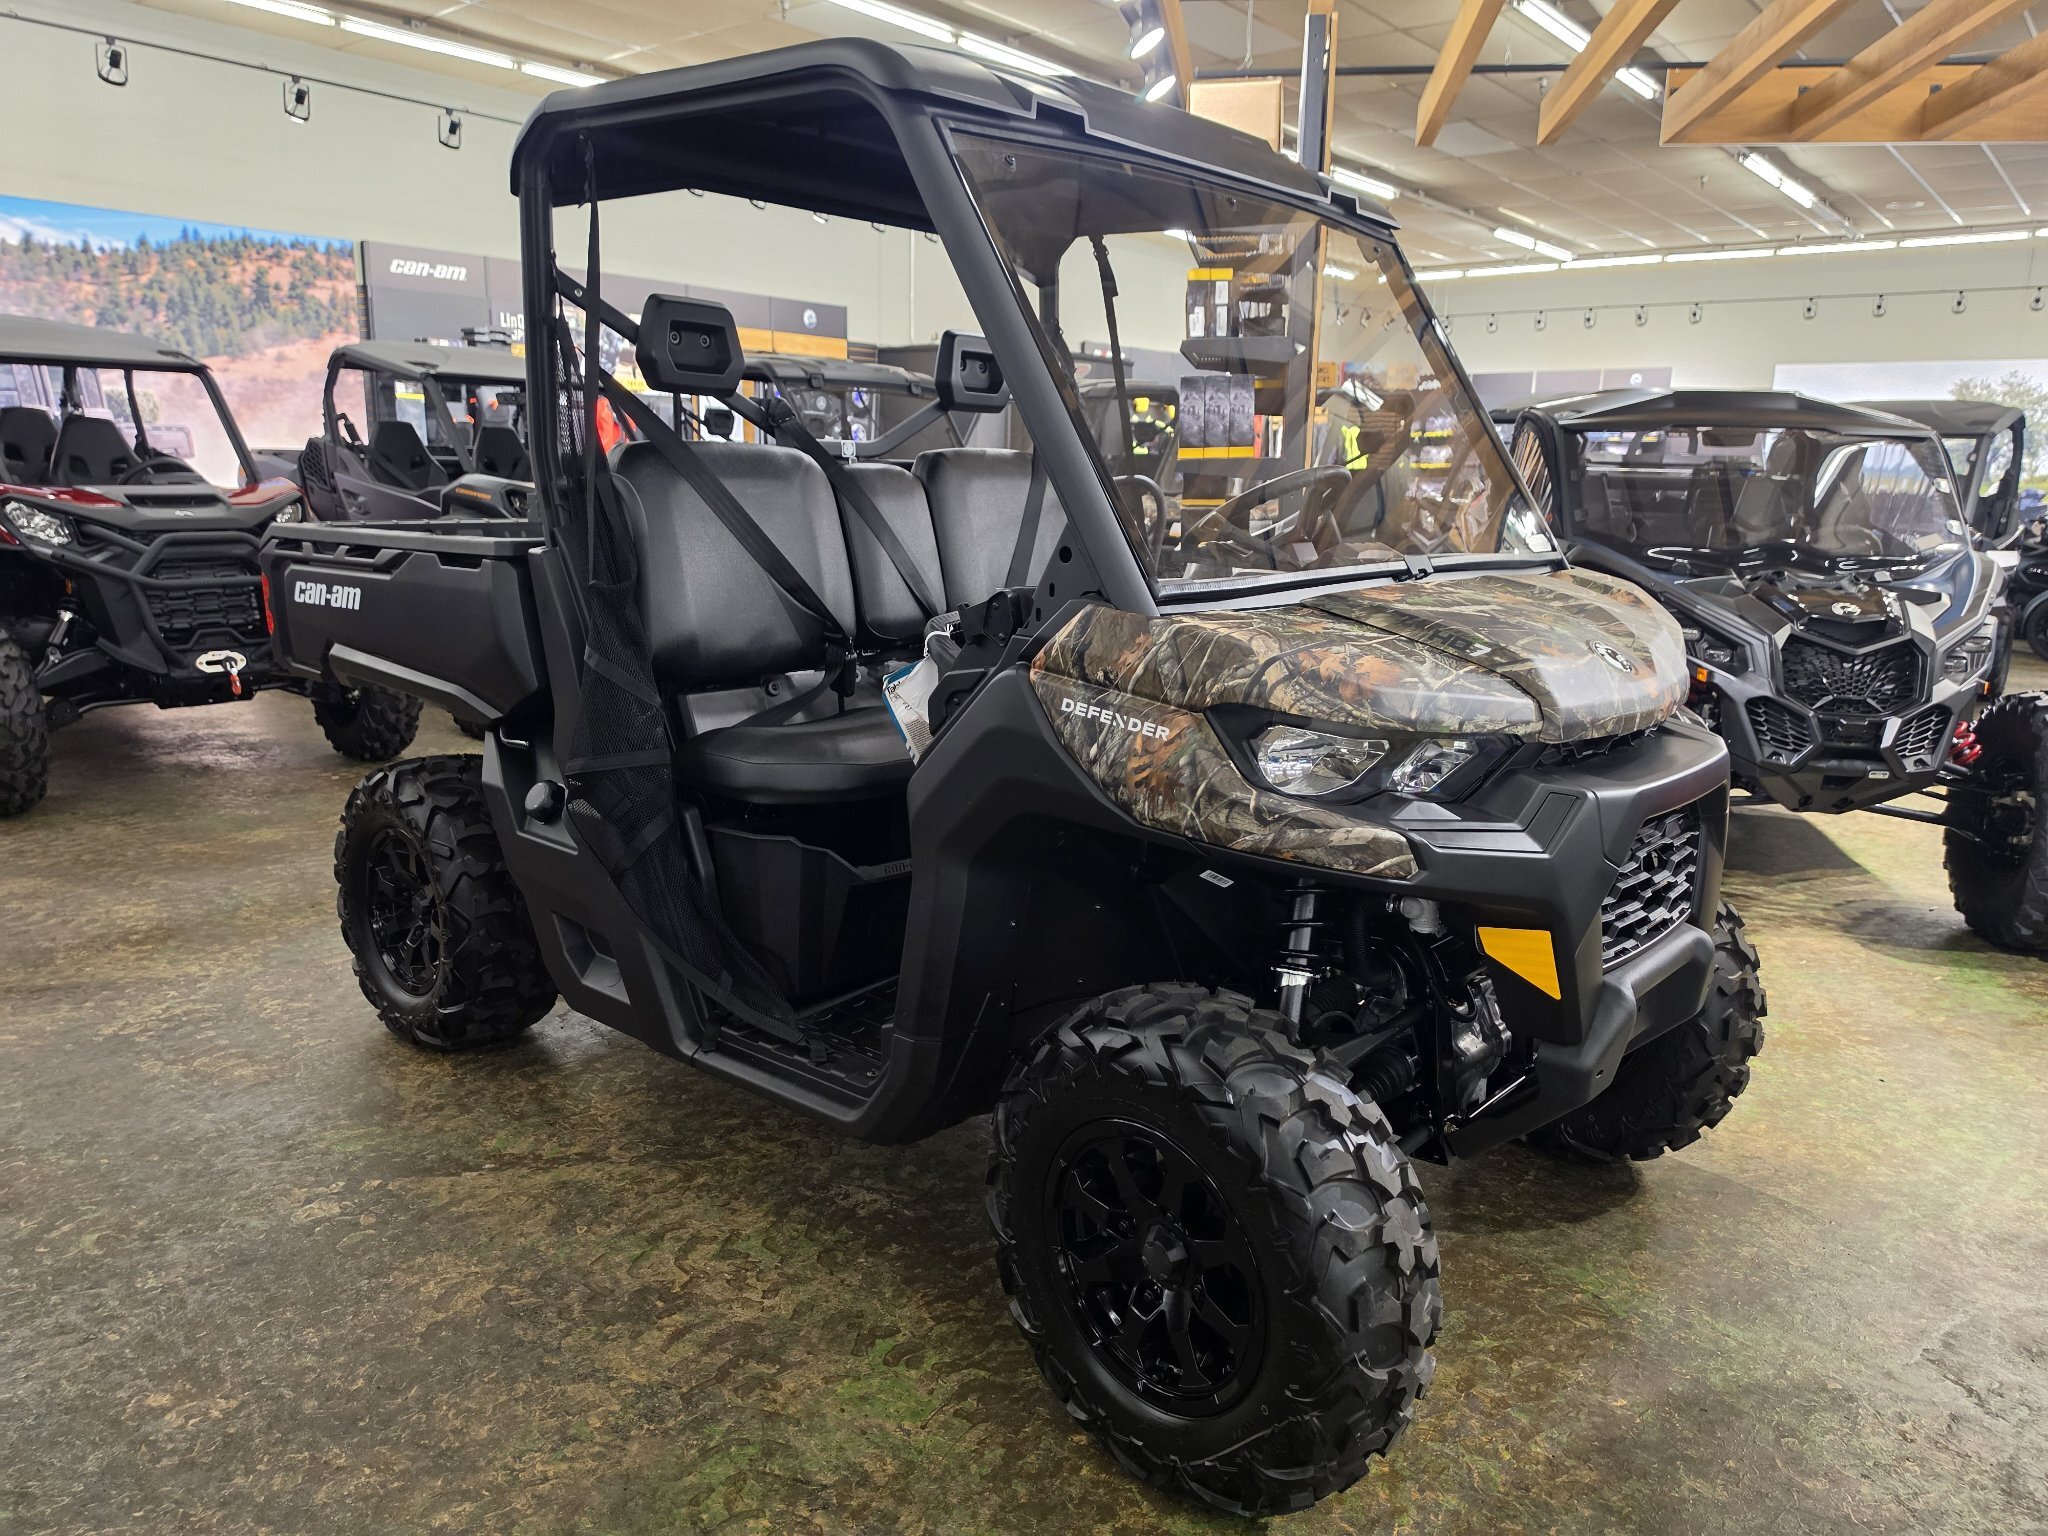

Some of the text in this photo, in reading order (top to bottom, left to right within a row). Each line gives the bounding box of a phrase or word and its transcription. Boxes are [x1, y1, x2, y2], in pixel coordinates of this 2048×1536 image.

[390, 258, 467, 281] can-am
[294, 580, 361, 611] can-am
[1427, 628, 1492, 657] HD7
[1060, 697, 1170, 742] DEFENDER
